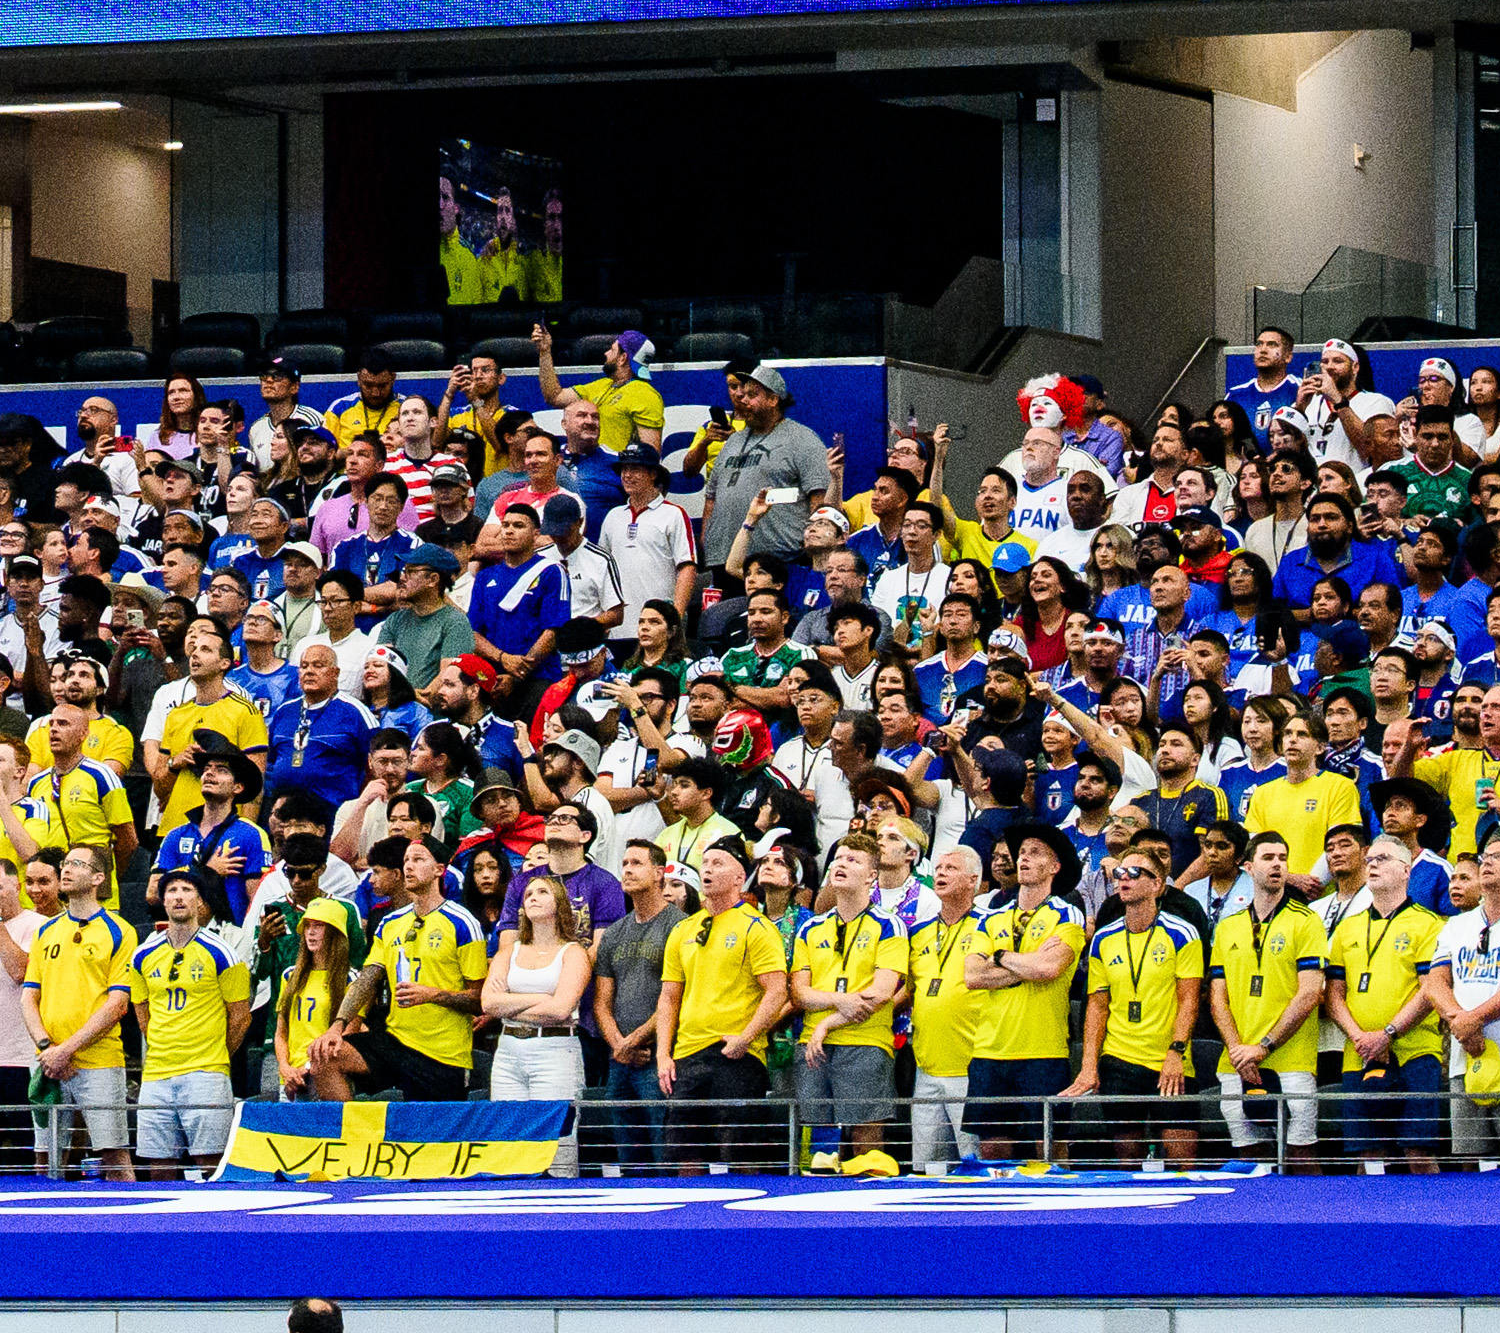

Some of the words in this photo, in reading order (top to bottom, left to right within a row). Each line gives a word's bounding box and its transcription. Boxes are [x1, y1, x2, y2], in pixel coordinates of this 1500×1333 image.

[1006, 507, 1061, 532] APAN
[41, 943, 62, 961] 10
[165, 987, 188, 1011] 10
[455, 1141, 489, 1177] IF
